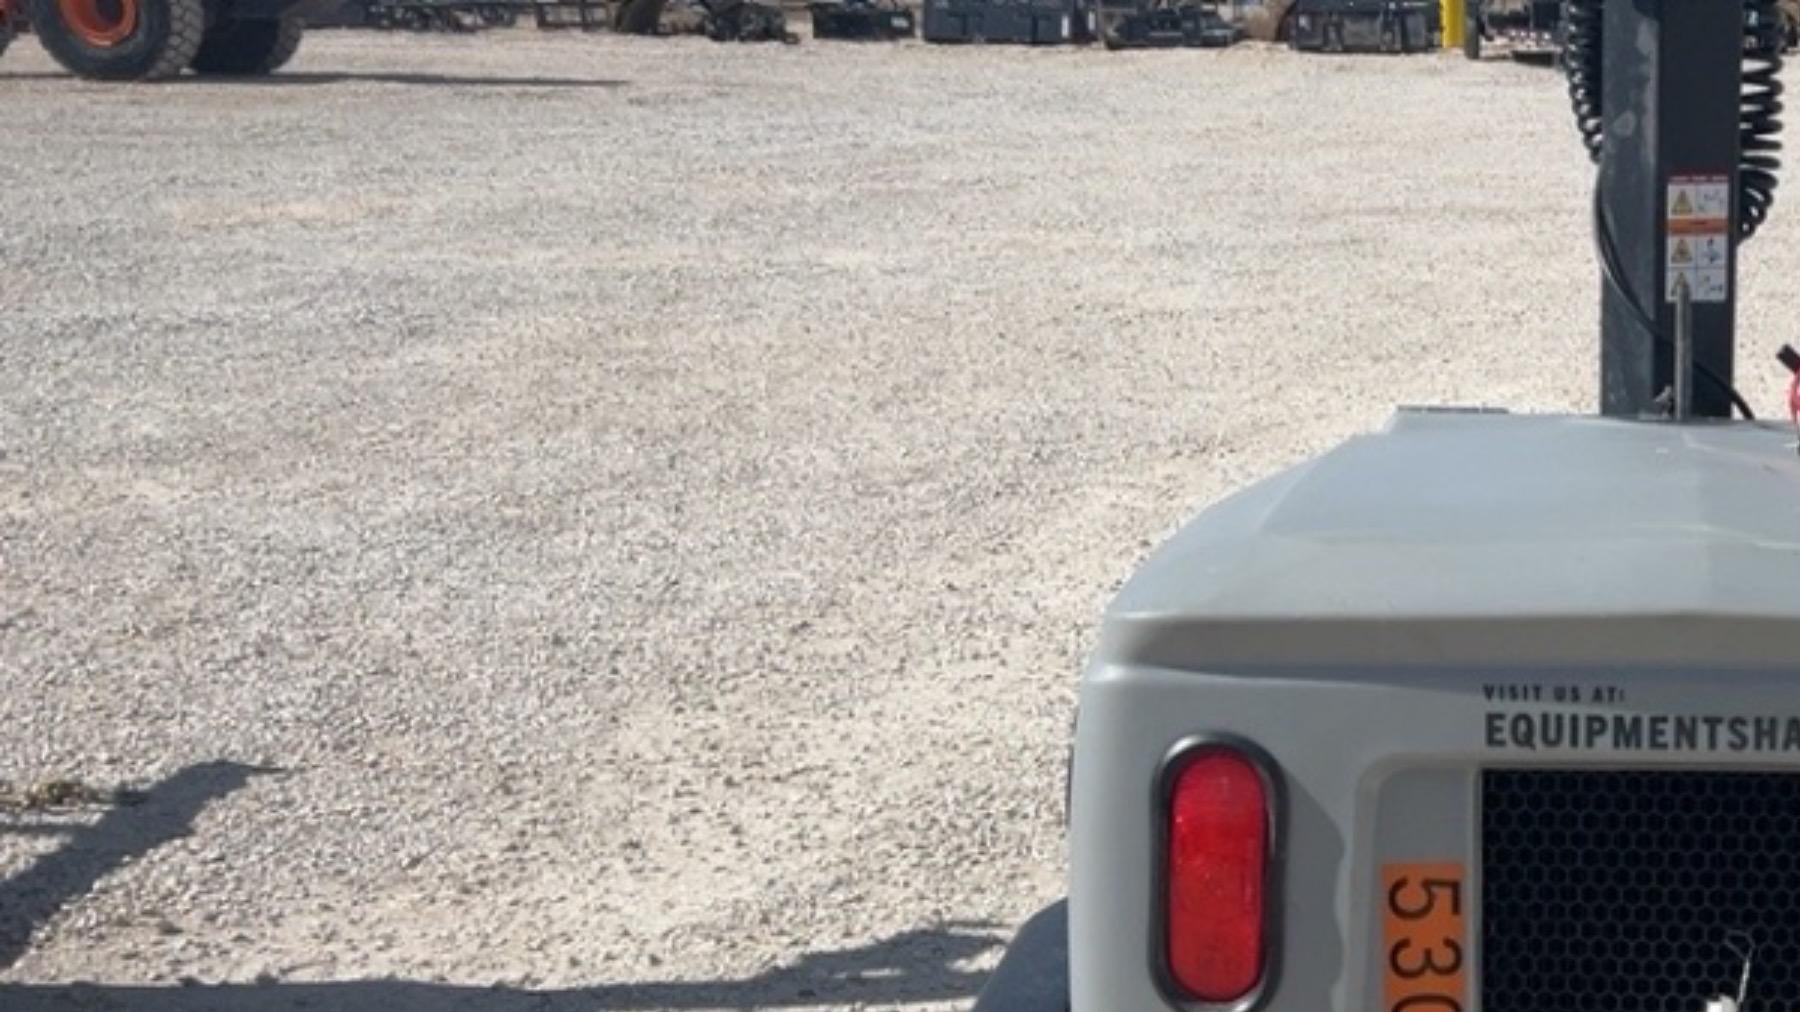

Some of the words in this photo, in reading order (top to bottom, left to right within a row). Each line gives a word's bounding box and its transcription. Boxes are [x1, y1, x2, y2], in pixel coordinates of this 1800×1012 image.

[1483, 684, 1543, 701] VISIT
[1553, 685, 1581, 702] US
[1591, 686, 1626, 703] AT:
